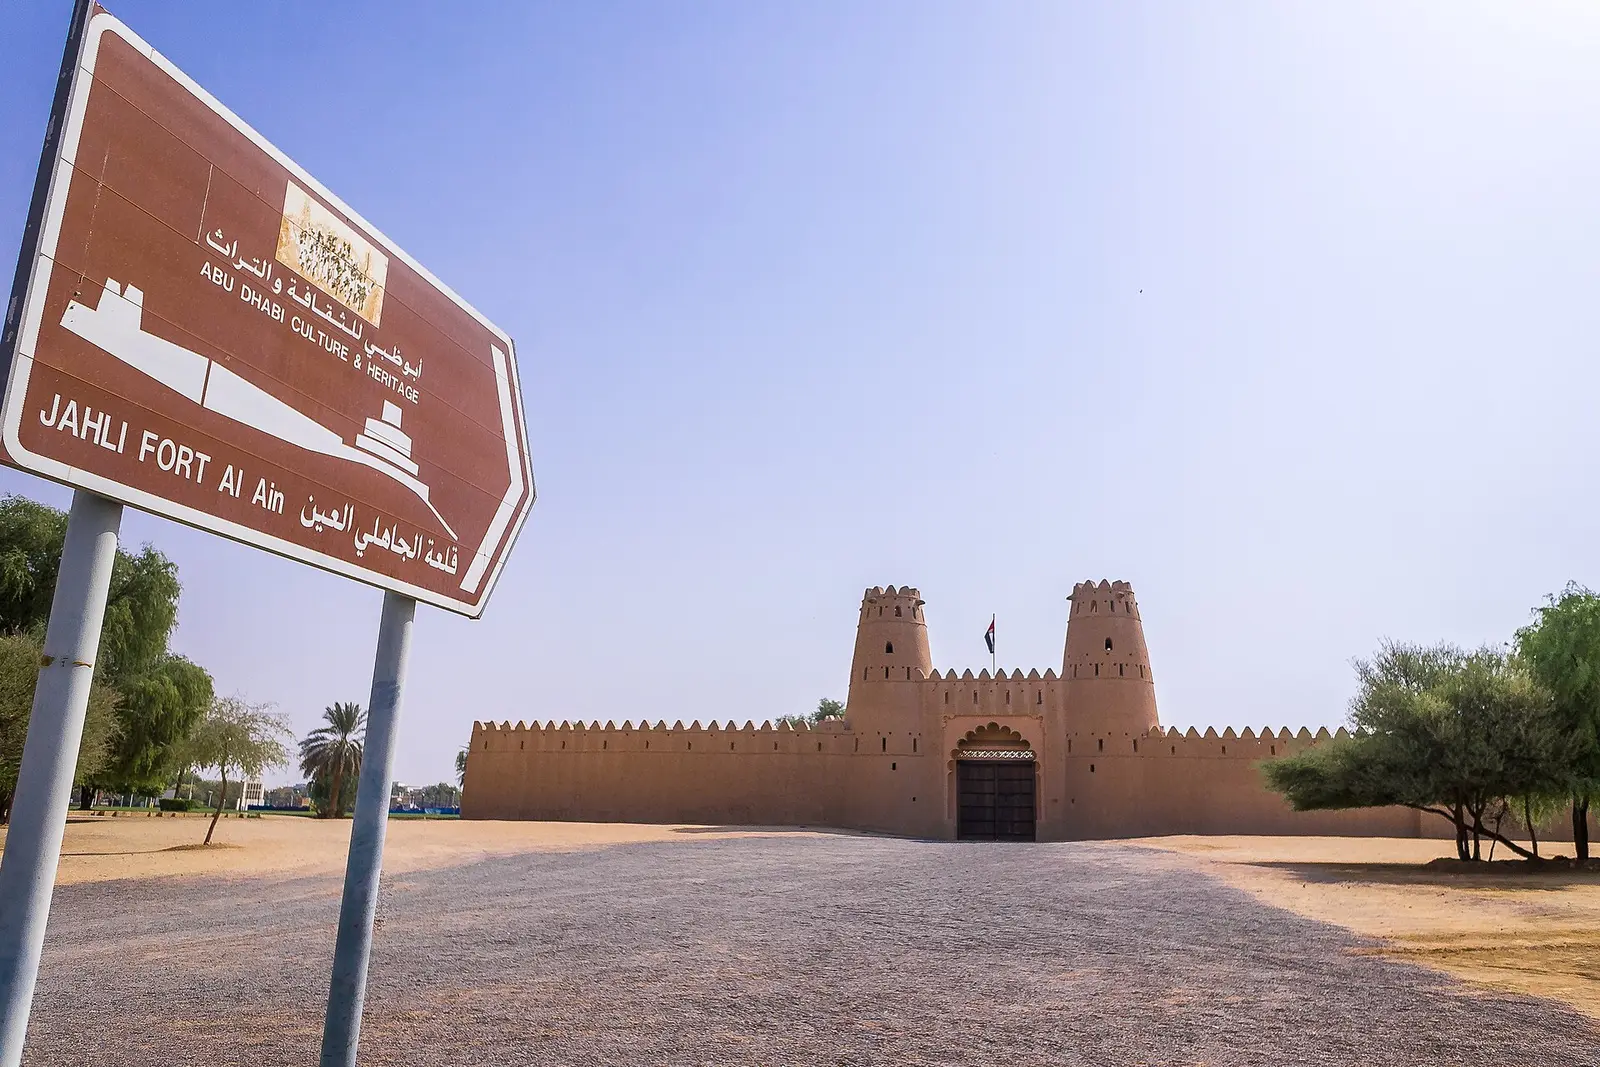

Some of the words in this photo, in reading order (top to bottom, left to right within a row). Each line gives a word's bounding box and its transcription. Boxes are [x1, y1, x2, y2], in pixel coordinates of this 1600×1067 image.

[205, 228, 272, 281] التراث
[200, 260, 235, 292] ABU
[240, 283, 285, 324] DHABI
[290, 316, 349, 362] CULTURE
[353, 353, 362, 370] &
[367, 361, 419, 405] HERITAGE
[286, 278, 364, 340] للثقافة
[39, 393, 129, 454] JAHLI
[138, 429, 212, 484] FORT
[218, 464, 244, 498] Al
[251, 477, 285, 515] Ain
[300, 495, 354, 532] العين
[354, 516, 423, 563] الجاهلي
[424, 537, 459, 575] قلعة
